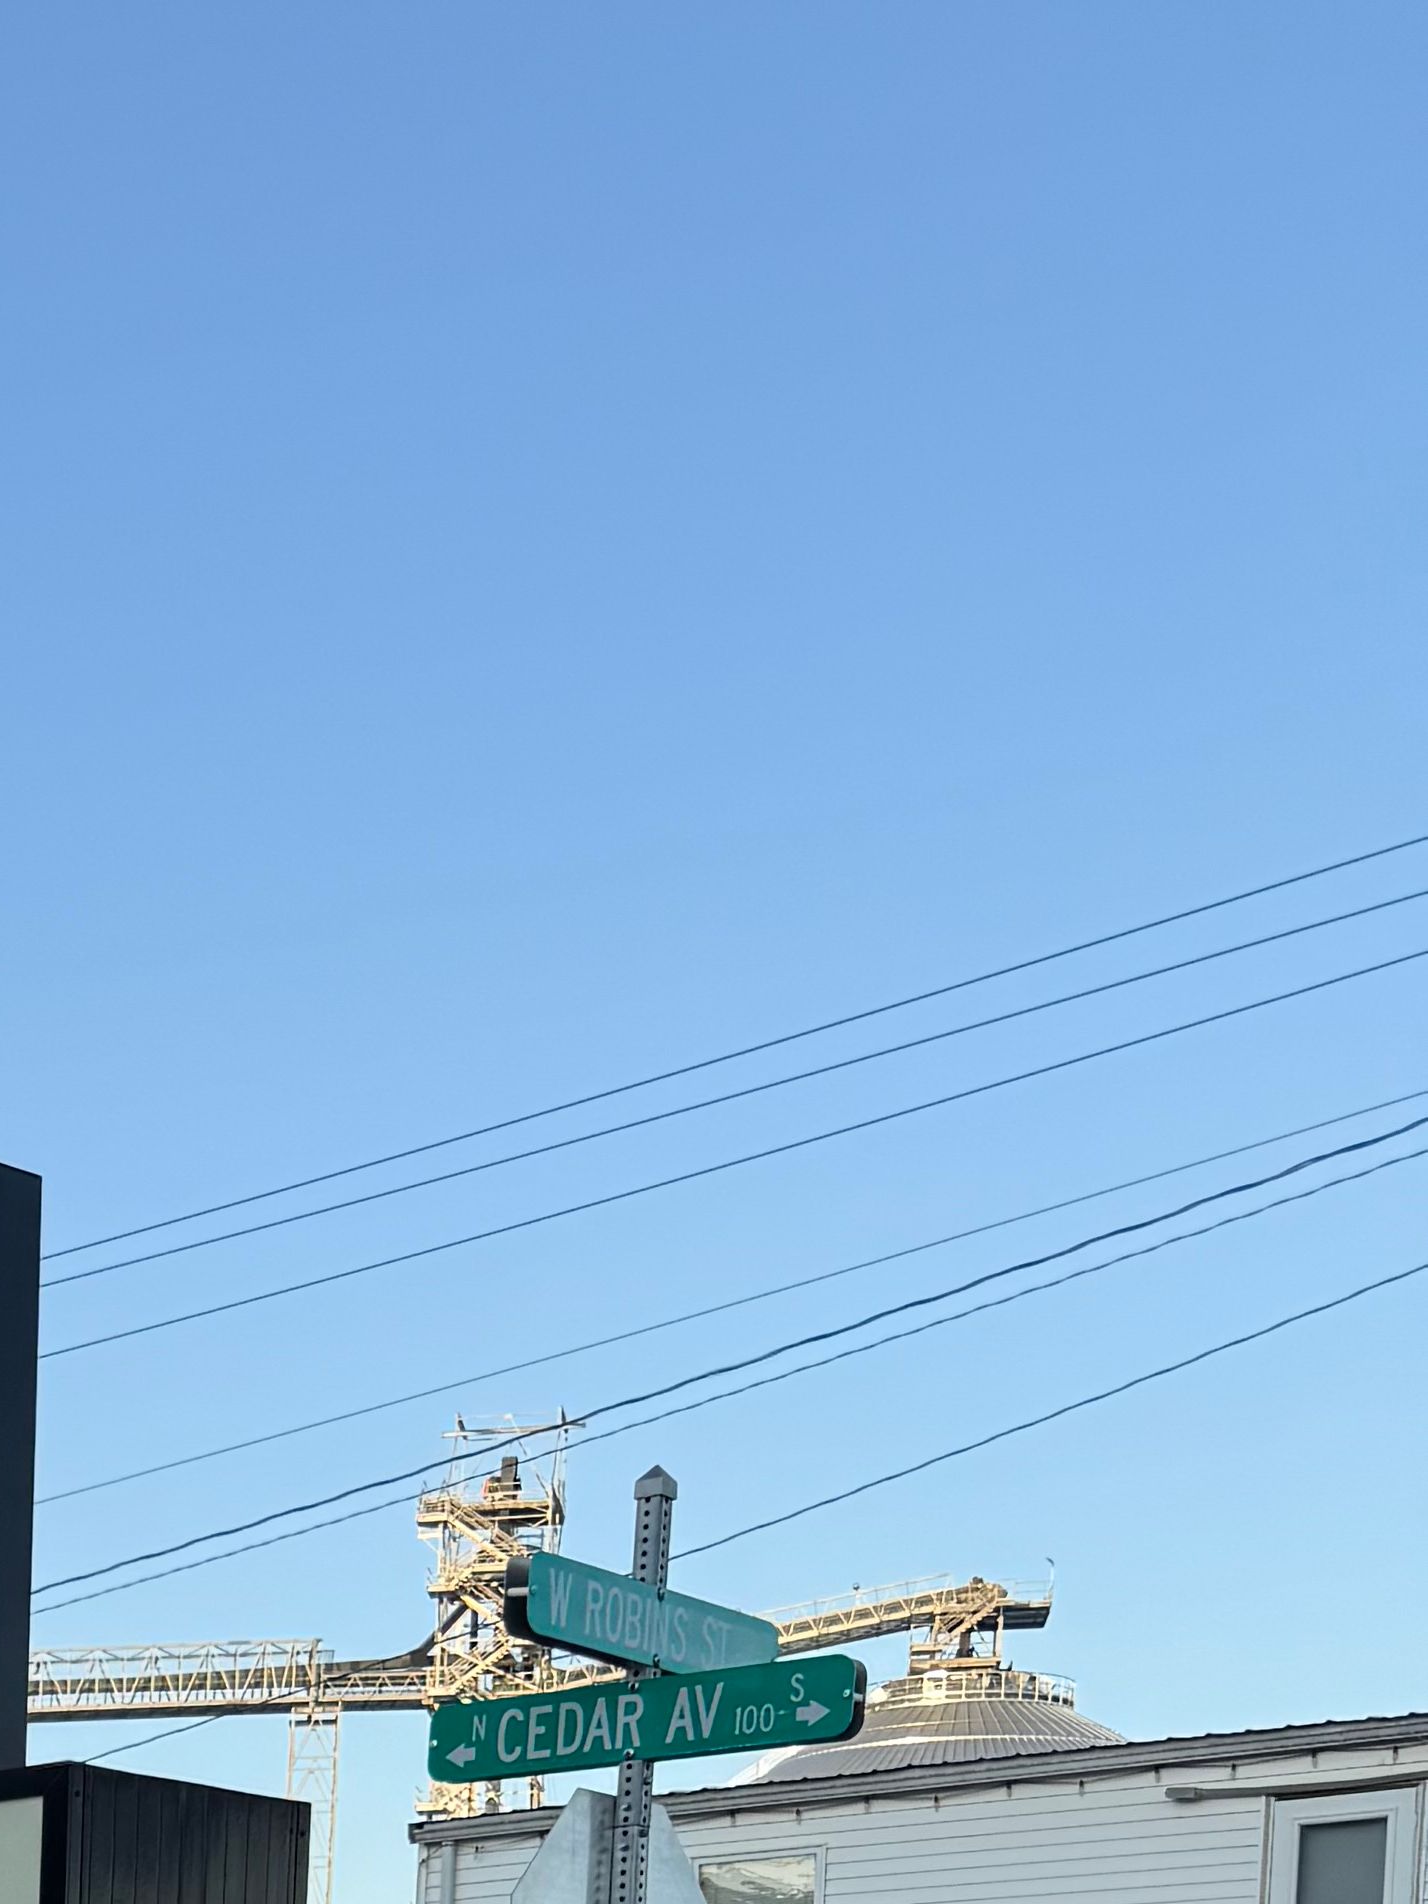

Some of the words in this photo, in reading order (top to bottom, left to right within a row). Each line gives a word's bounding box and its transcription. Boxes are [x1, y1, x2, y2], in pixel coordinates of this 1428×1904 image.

[549, 1567, 573, 1628] W
[584, 1579, 689, 1663] ROBINS
[701, 1615, 734, 1667] ST
[472, 1714, 486, 1742] N
[497, 1692, 644, 1763] CEDAR
[665, 1681, 724, 1744] AV
[790, 1672, 805, 1702] S
